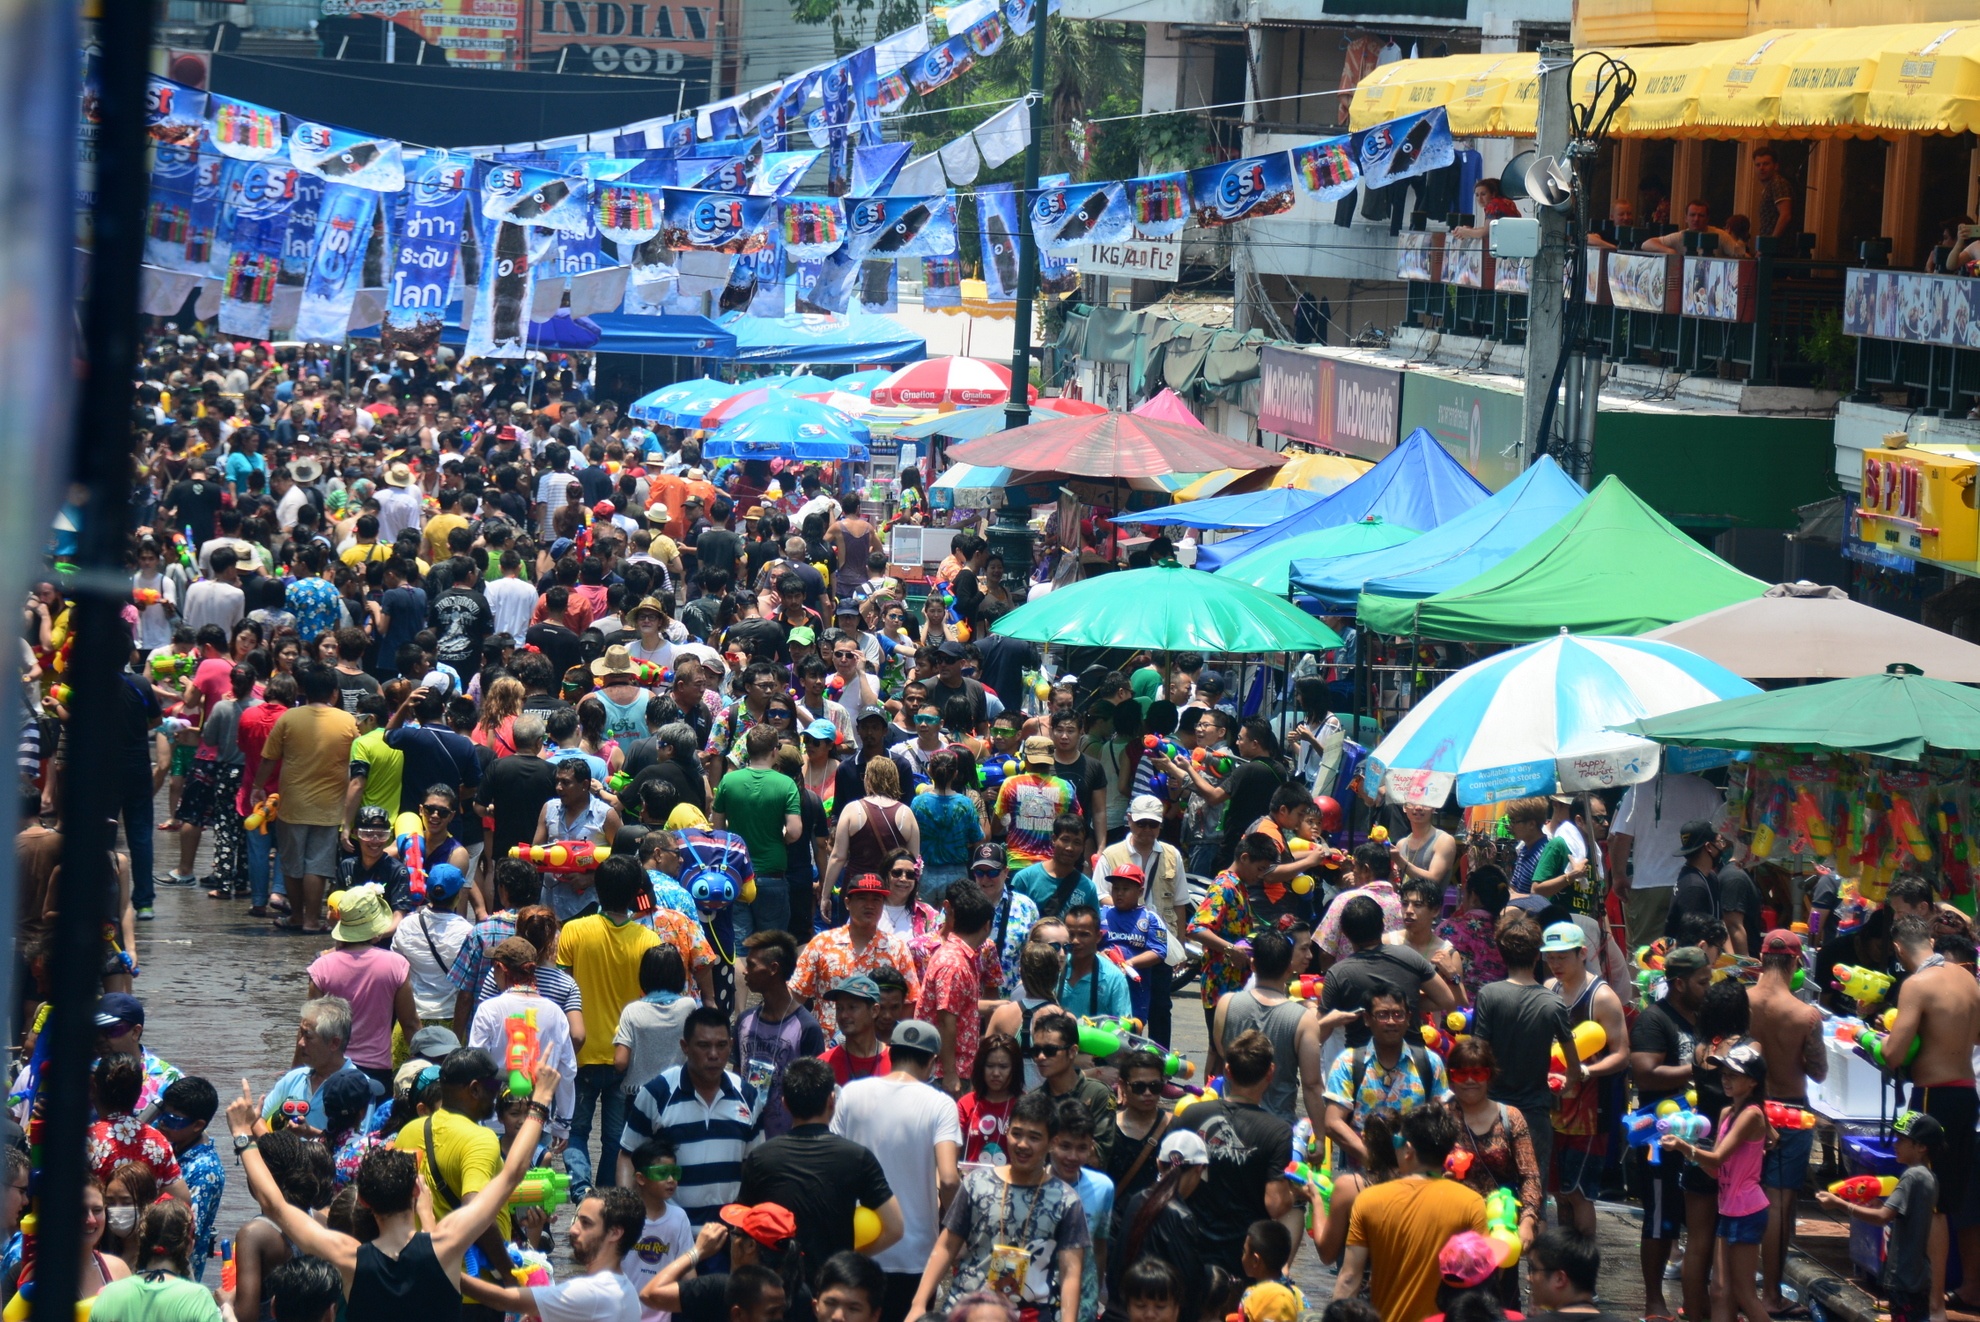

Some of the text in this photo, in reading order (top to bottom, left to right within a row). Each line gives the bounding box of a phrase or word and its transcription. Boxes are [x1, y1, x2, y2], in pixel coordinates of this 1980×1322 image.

[538, 0, 714, 42] INDIAN
[579, 43, 685, 75] OOD
[244, 168, 299, 201] est
[1222, 164, 1265, 202] est
[694, 201, 744, 232] est
[854, 201, 886, 227] est
[401, 246, 449, 268] ระดับ
[394, 271, 442, 308] โลก
[901, 389, 936, 402] Carnation
[1262, 363, 1316, 426] McDonald's
[1336, 378, 1394, 446] McDonald's
[1478, 767, 1509, 780] Available
[1518, 764, 1533, 776] any
[1573, 758, 1606, 771] Happy
[1578, 767, 1614, 779] Tourist
[1469, 771, 1542, 790] convenience stores
[1107, 931, 1146, 943] YOKOHAMA
